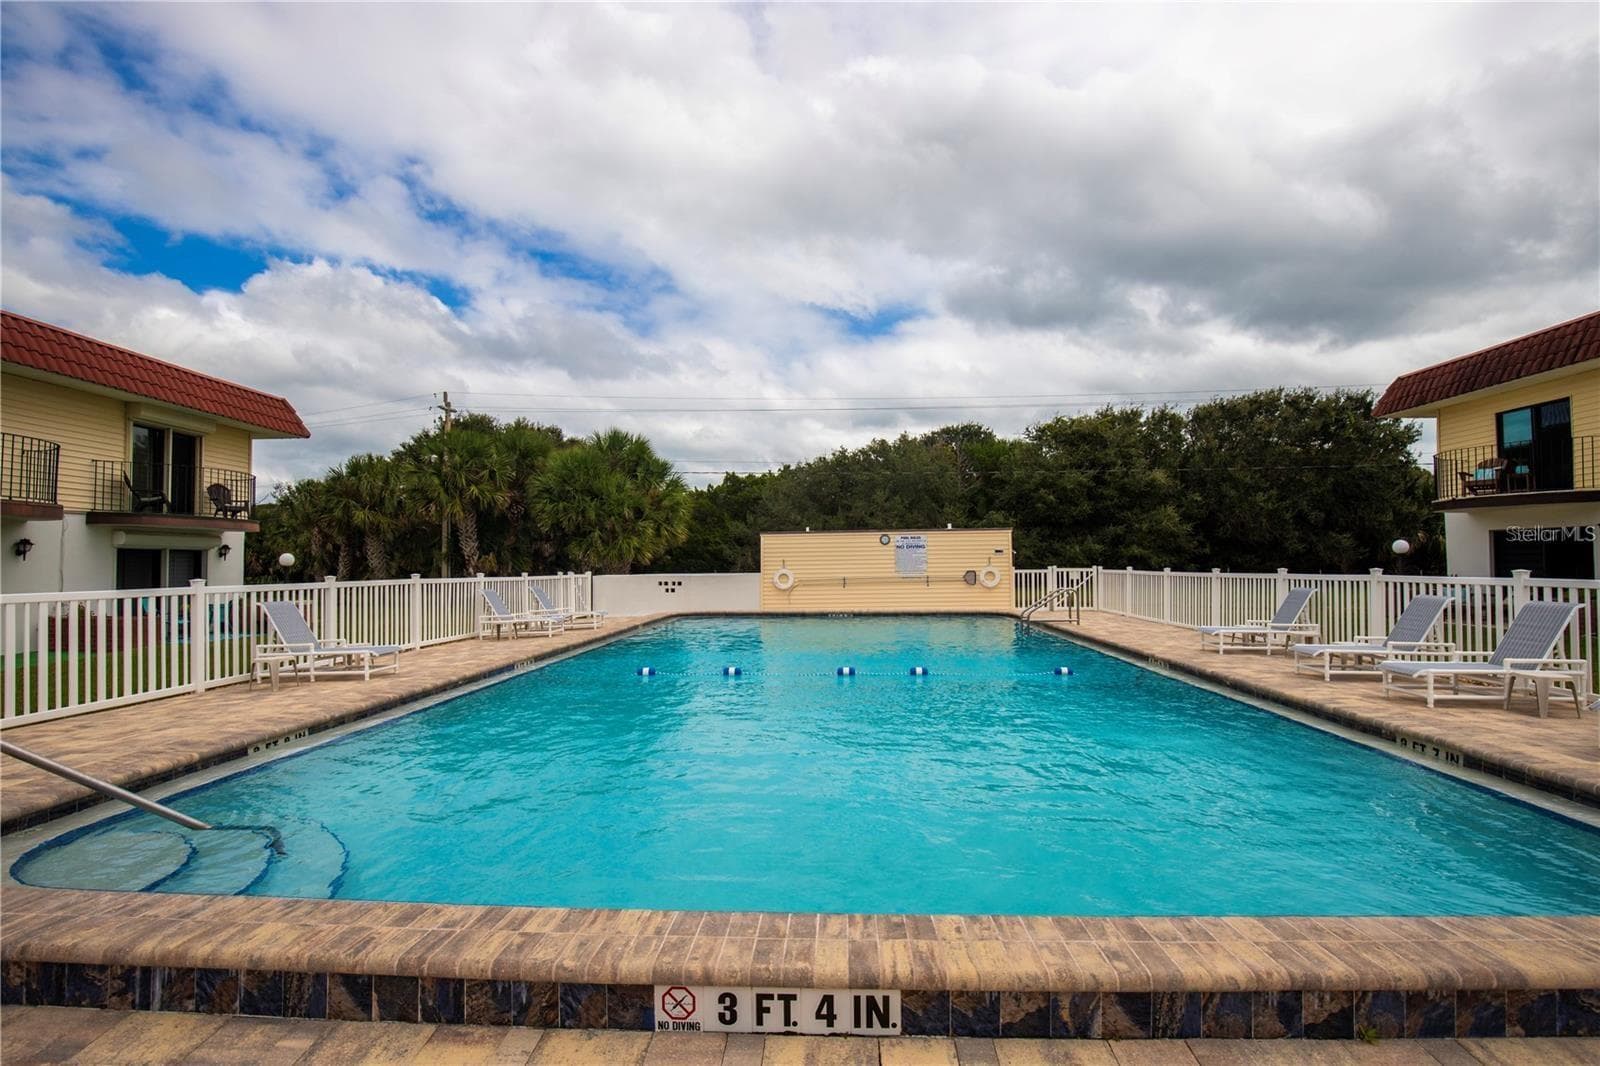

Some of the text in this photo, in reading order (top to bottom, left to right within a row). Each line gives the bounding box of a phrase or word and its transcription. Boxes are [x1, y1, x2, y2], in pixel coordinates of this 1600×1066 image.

[717, 992, 897, 1029] 3 FT. 4 IN.
[657, 1021, 701, 1032] NO DIVING
